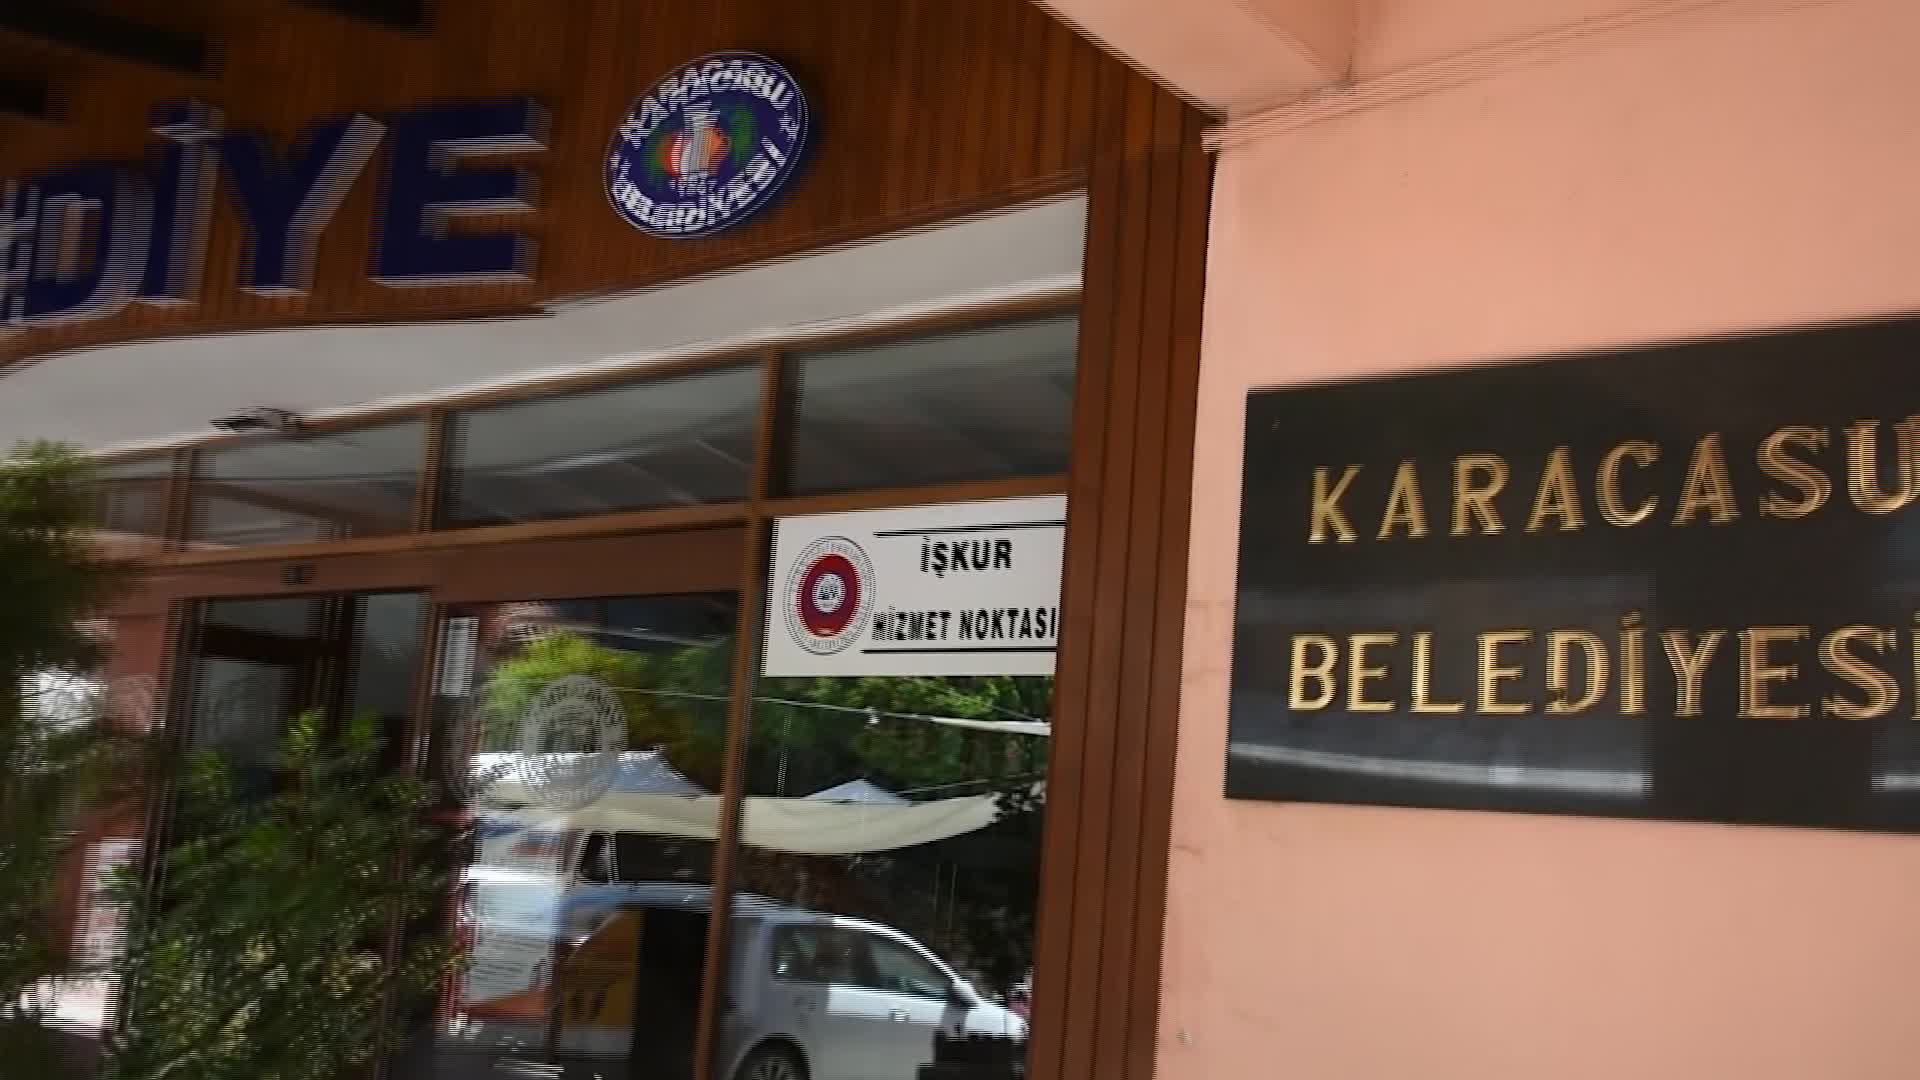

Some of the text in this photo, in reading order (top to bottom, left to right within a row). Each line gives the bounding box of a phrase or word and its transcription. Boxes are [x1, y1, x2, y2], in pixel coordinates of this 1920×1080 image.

[620, 59, 795, 149] KARACASU
[1308, 414, 1920, 545] KARACASU
[920, 535, 1013, 579] İŞKUR
[871, 606, 1056, 641] HİZMET NOKTASI
